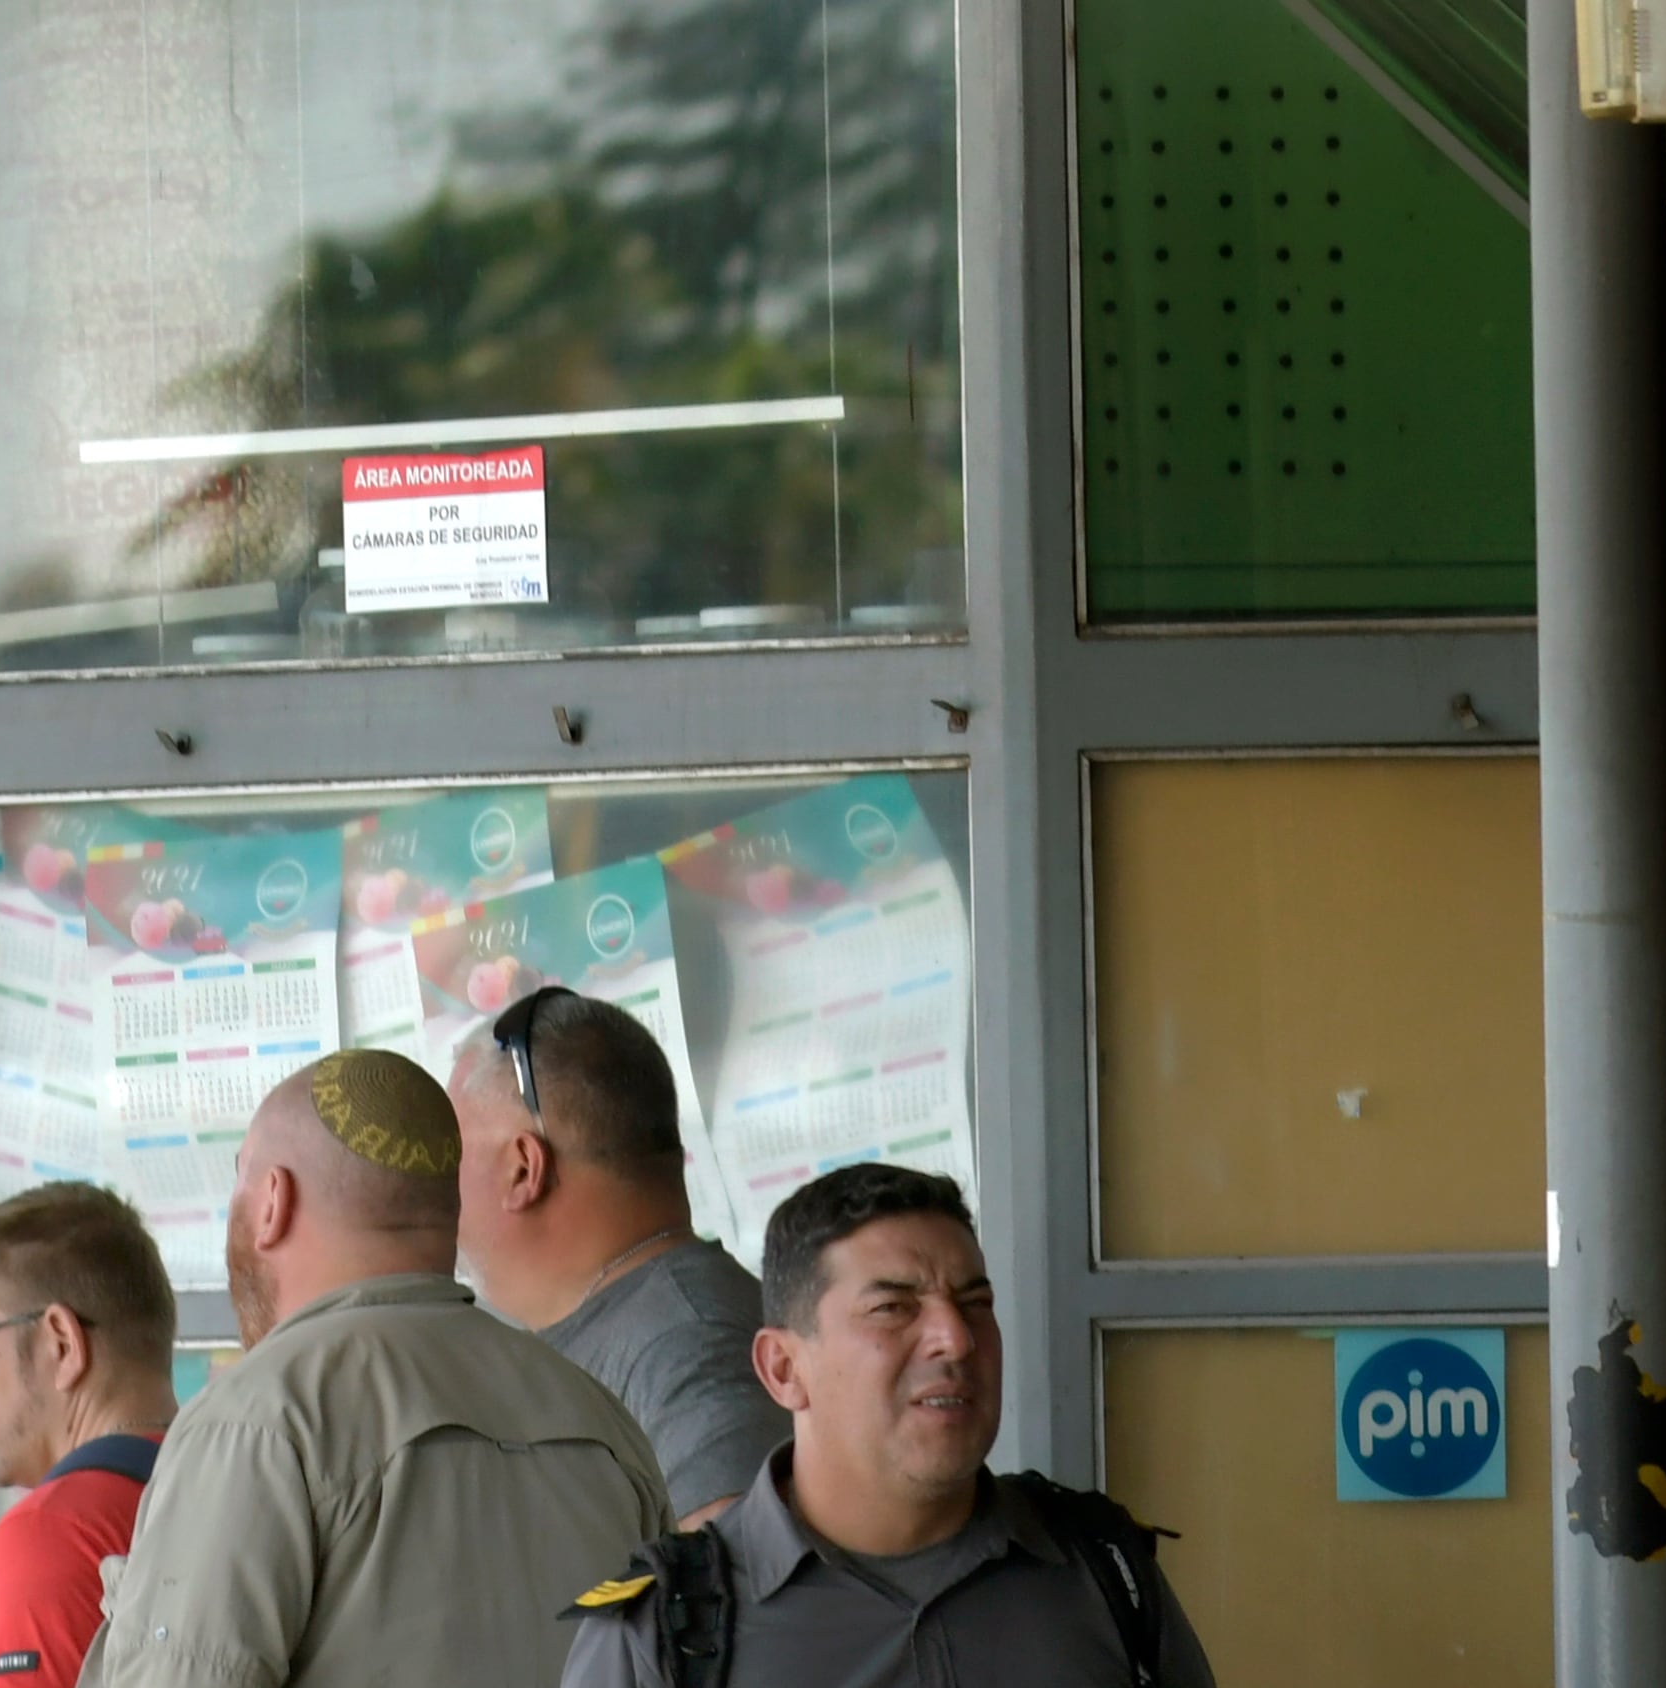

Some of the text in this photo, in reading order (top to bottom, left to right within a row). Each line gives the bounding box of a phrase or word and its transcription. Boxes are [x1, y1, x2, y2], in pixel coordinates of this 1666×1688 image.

[354, 459, 534, 489] ÁREA MONITOREADA
[428, 505, 460, 522] POR
[352, 523, 538, 550] CÁMARAS DE SEGURIDAD
[1358, 1369, 1489, 1459] pim
